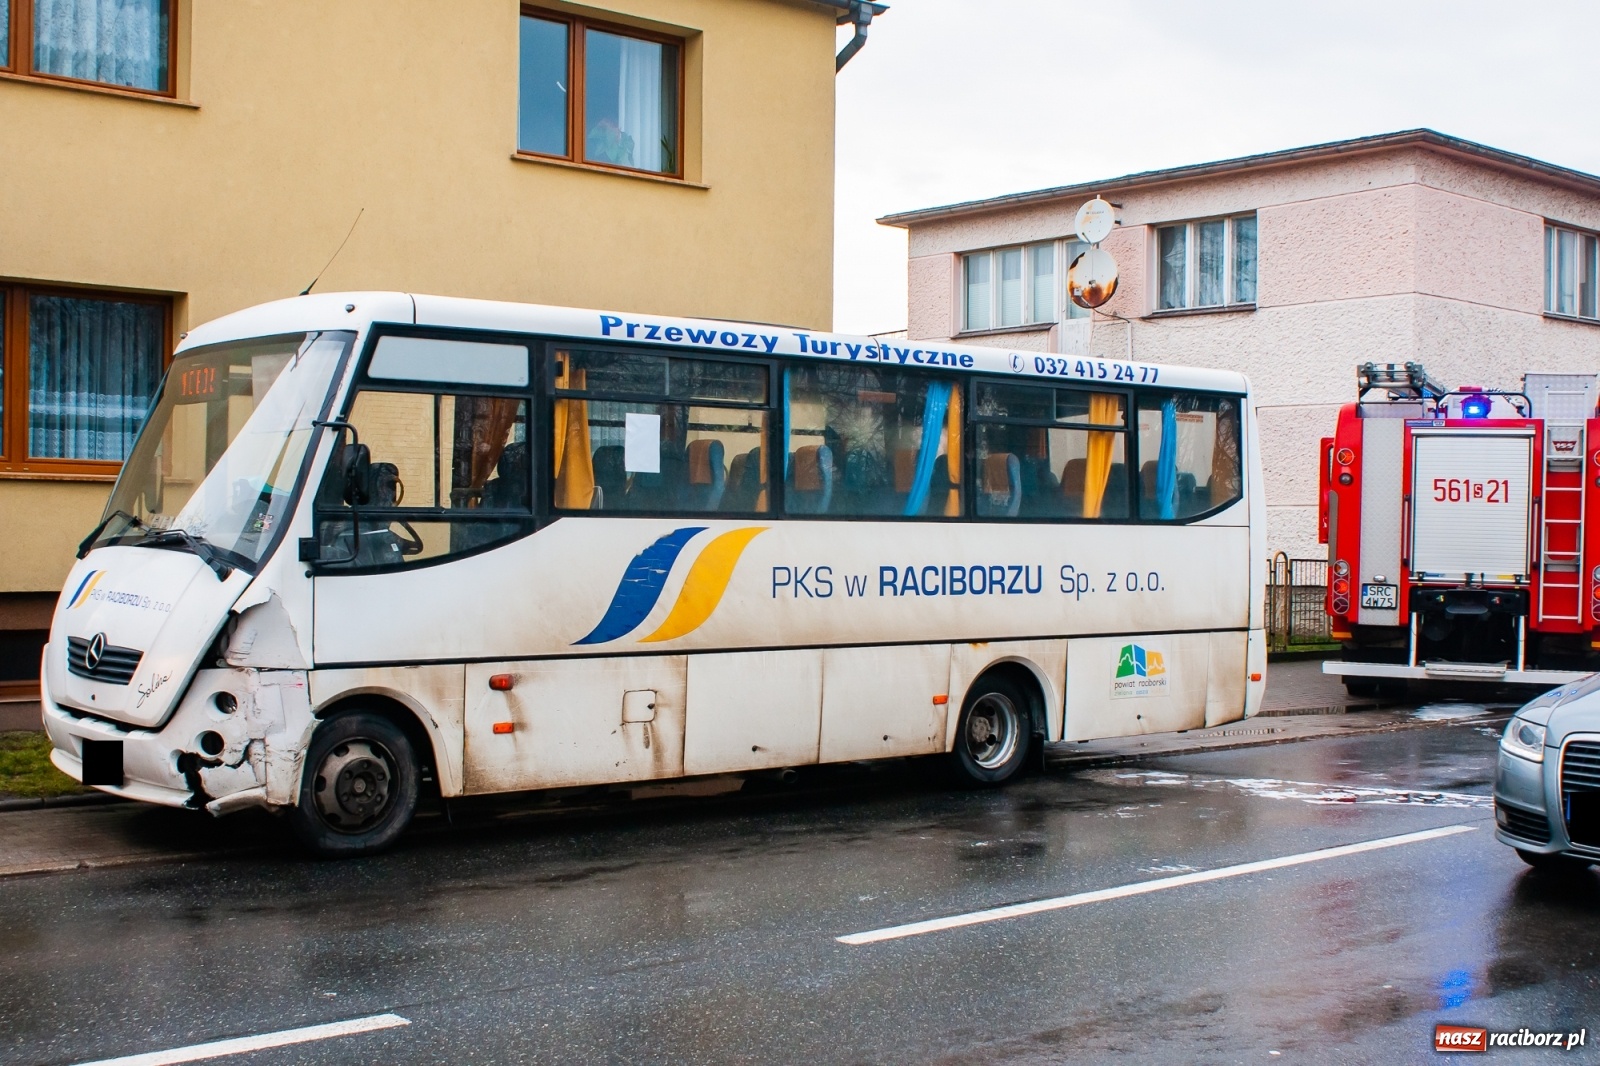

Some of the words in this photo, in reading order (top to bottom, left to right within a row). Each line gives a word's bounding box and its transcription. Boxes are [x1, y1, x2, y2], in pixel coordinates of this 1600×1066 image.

[599, 315, 779, 353] Przewozy
[792, 333, 974, 368] Turystyczne
[1034, 356, 1068, 376] 032
[1075, 360, 1107, 379] 415
[1113, 364, 1135, 382] 24
[1139, 366, 1159, 384] 77
[1433, 478, 1470, 502] 561
[1486, 479, 1509, 503] 21
[772, 566, 833, 599] PKS
[844, 575, 867, 597] w
[879, 565, 1042, 597] RACIBORZU
[1060, 564, 1095, 601] Sp.
[1106, 572, 1117, 592] z
[1125, 572, 1165, 592] o.o.
[1369, 586, 1391, 597] SRC
[1114, 681, 1136, 690] powiat
